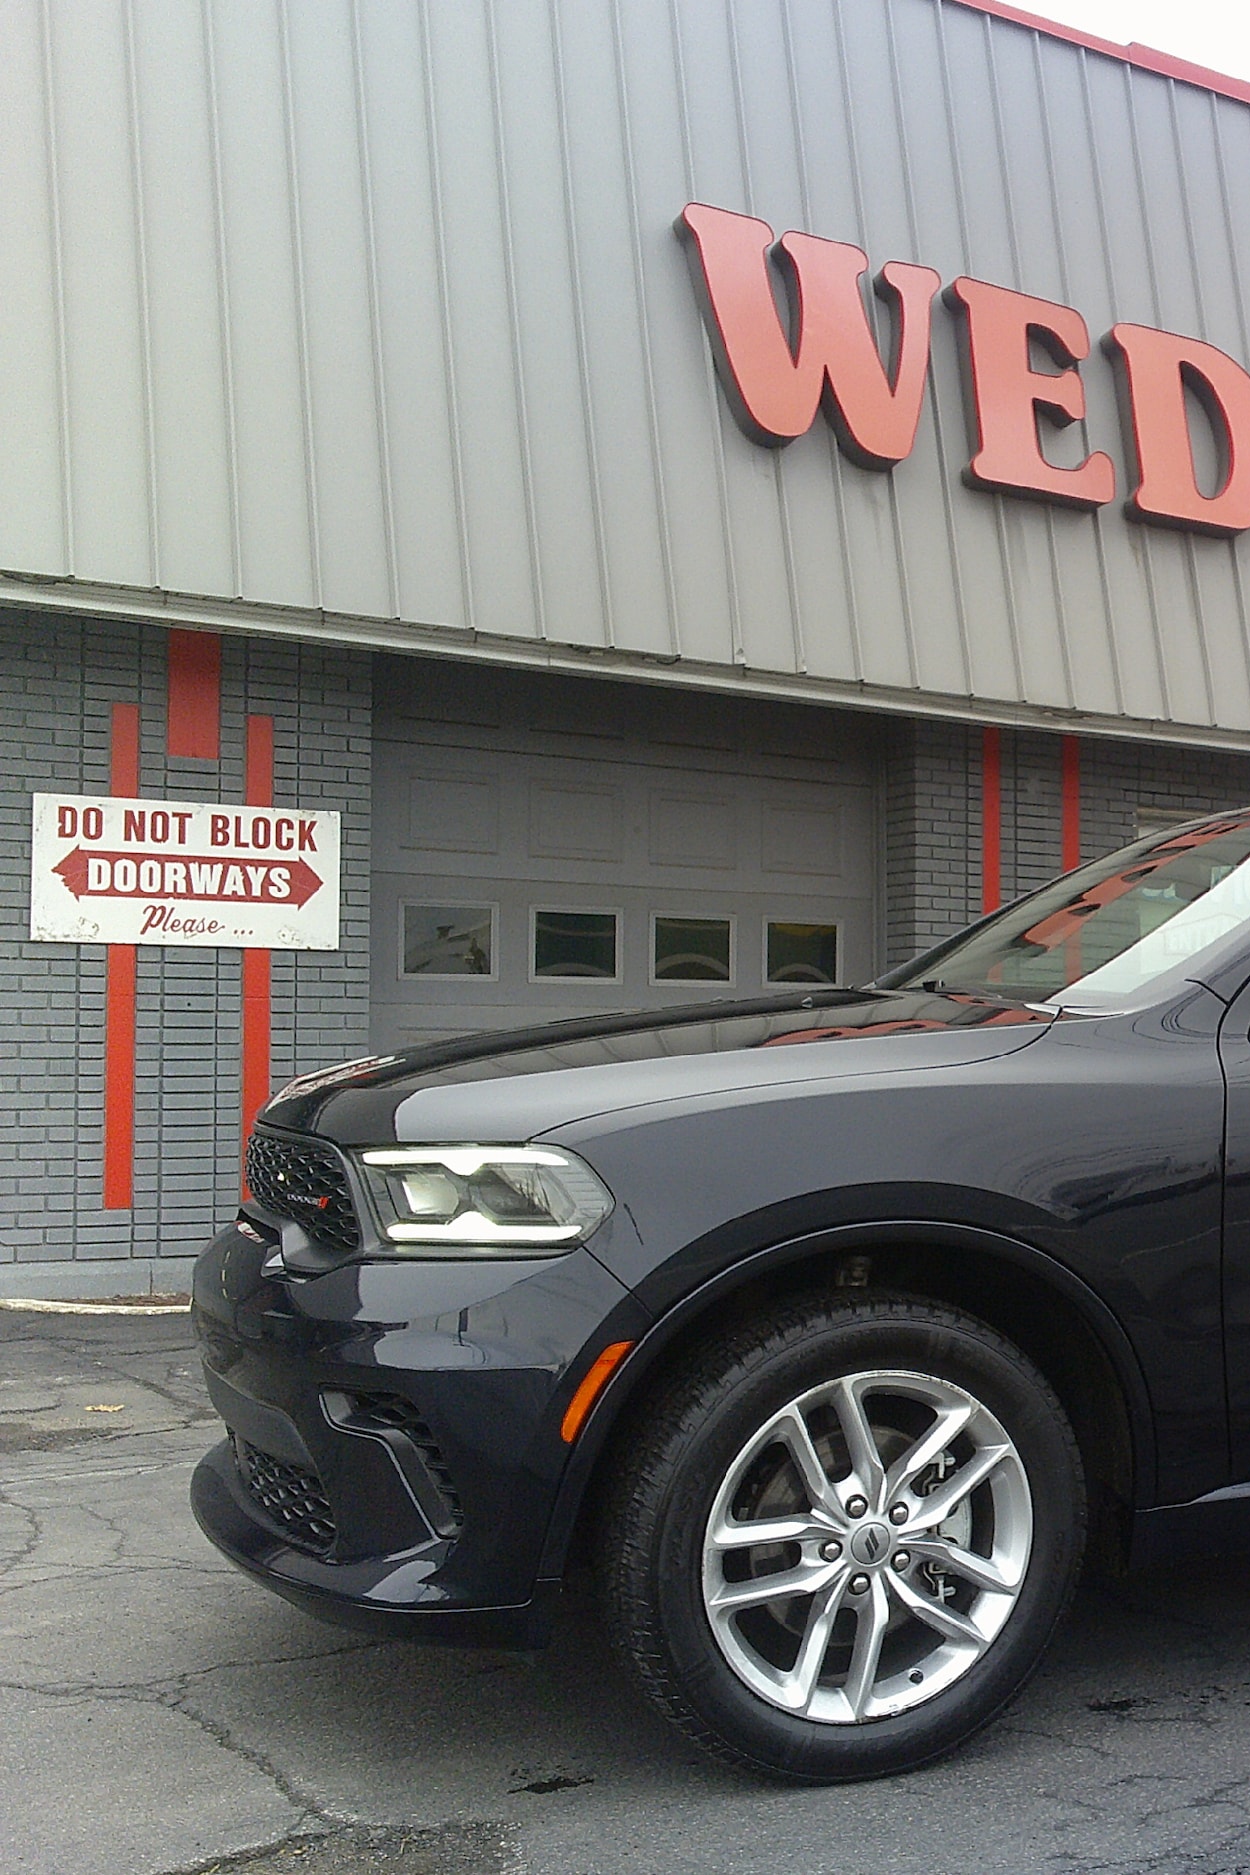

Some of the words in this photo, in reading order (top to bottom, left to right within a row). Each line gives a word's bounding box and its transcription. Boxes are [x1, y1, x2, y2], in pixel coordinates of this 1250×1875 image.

[57, 806, 103, 839] DO
[124, 810, 192, 845] NOT
[211, 814, 318, 852] BLOCK
[88, 858, 291, 898] DOORWAYS
[140, 905, 225, 935] Please
